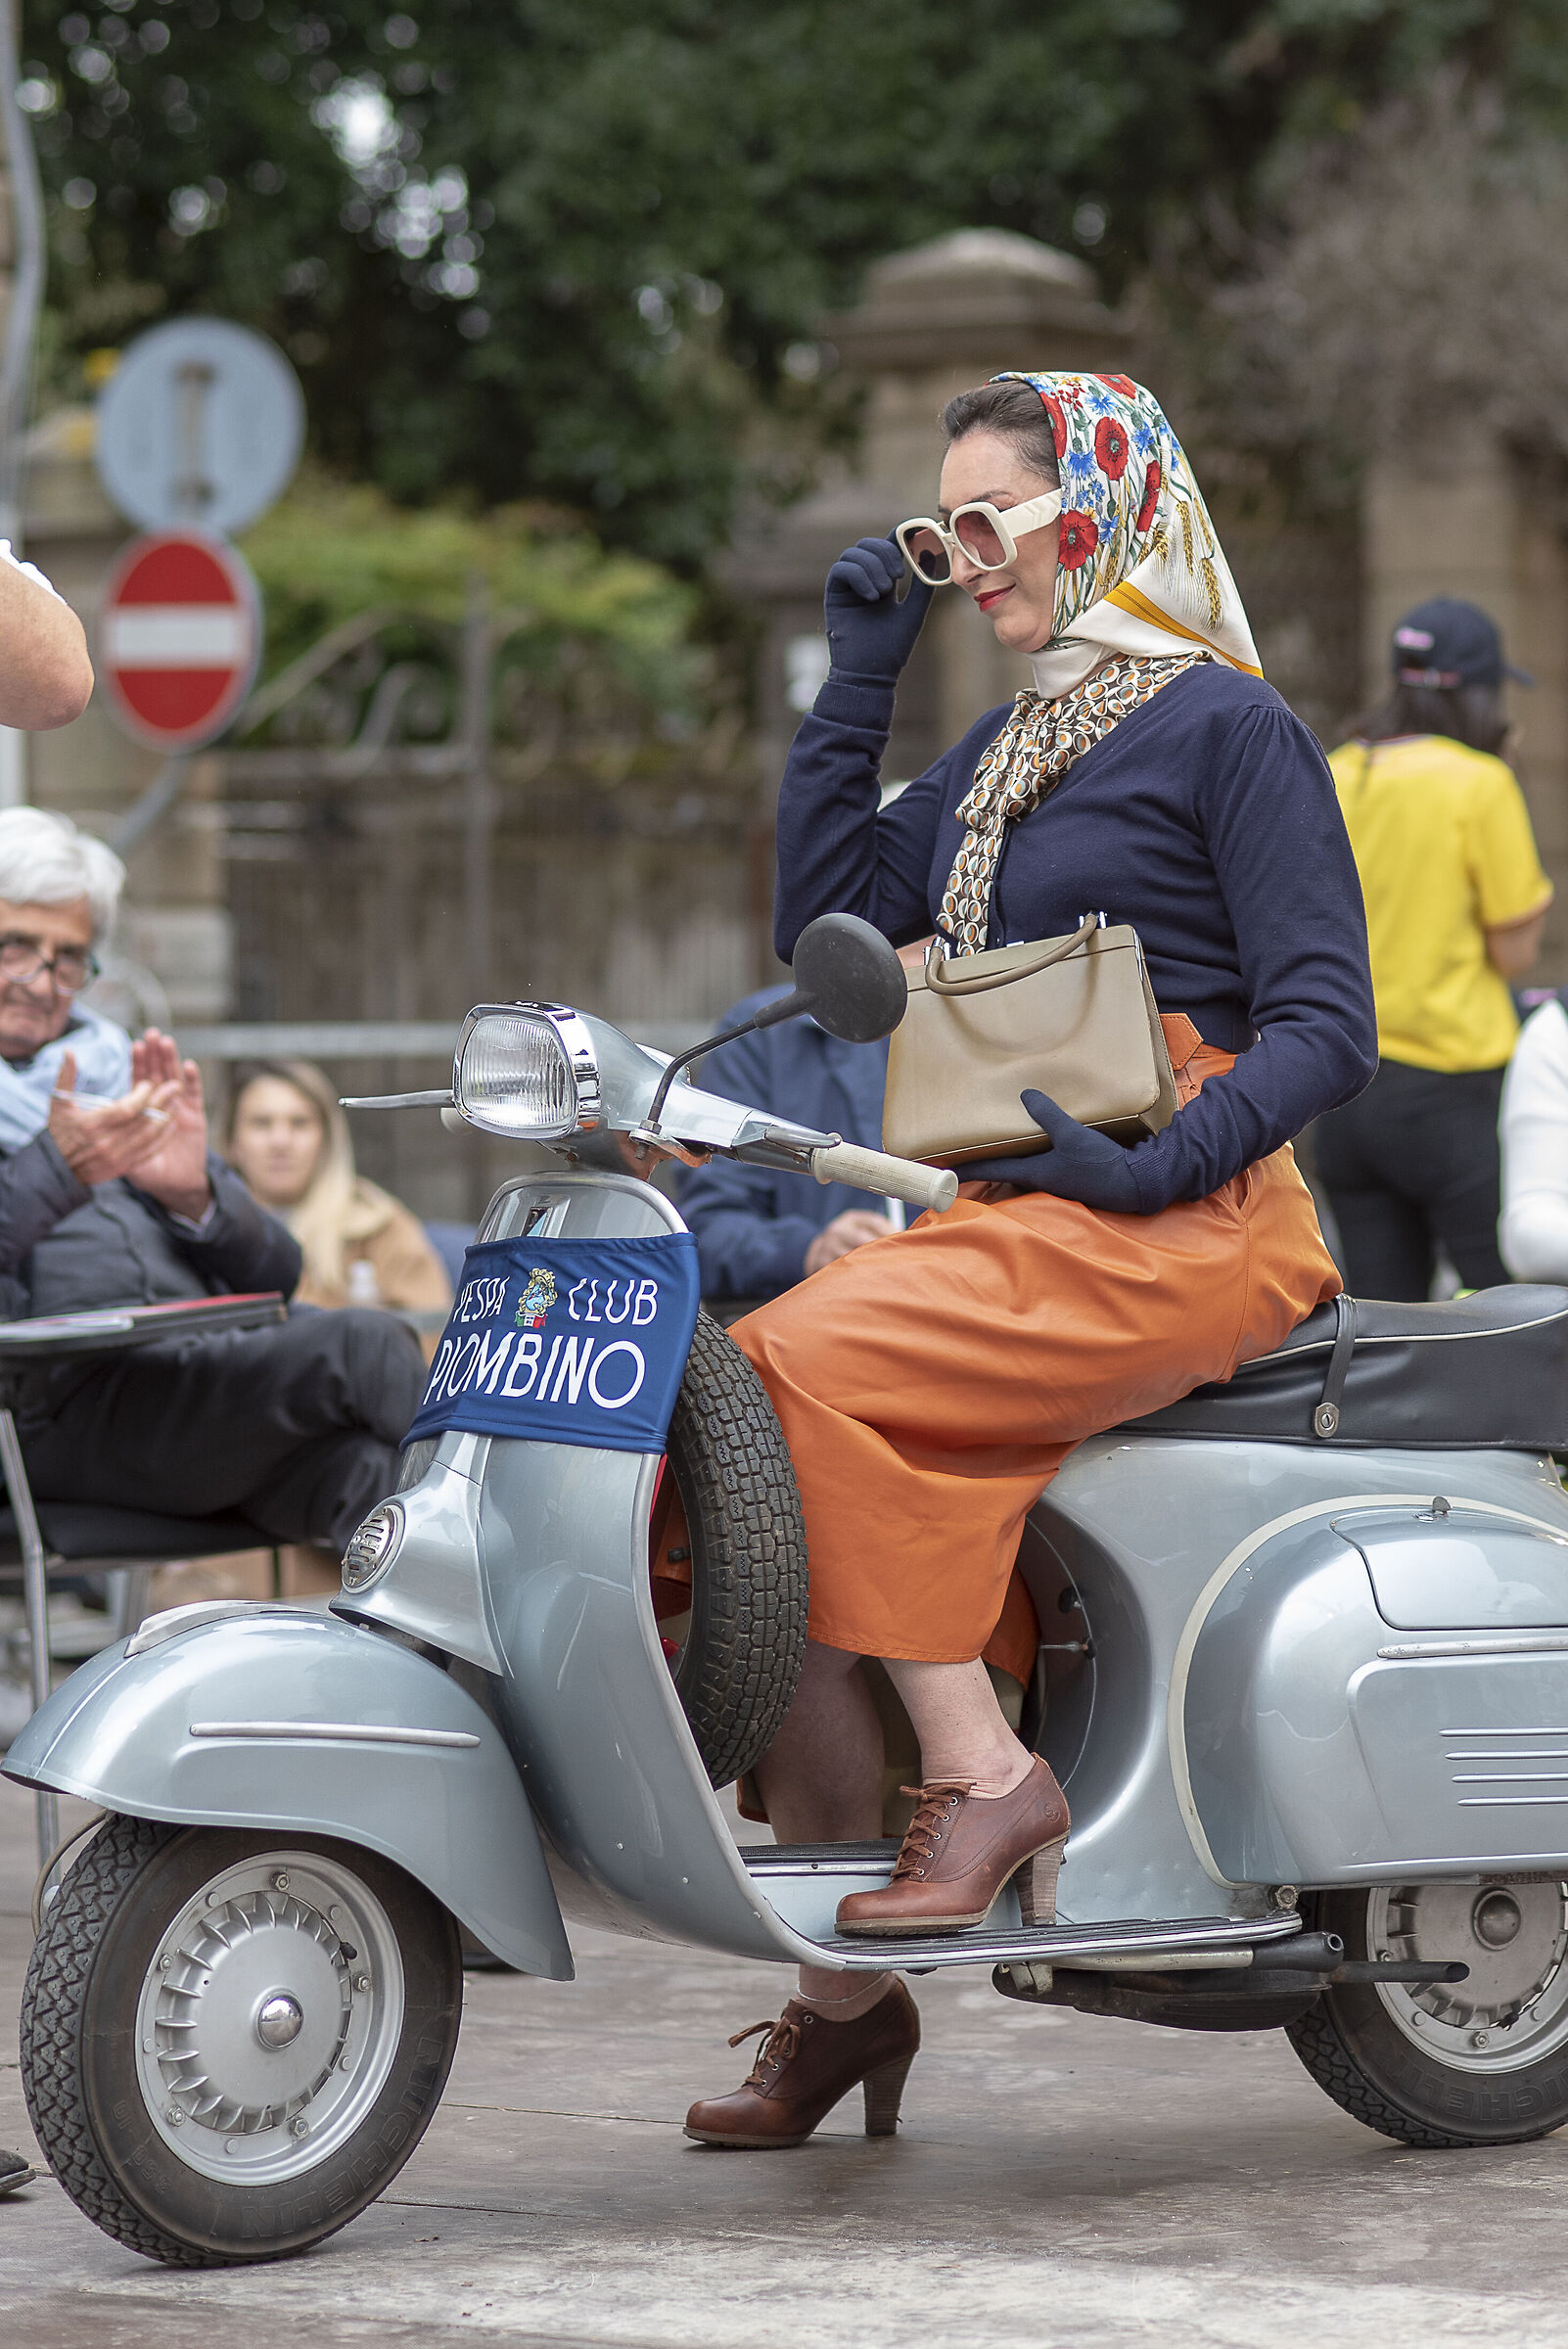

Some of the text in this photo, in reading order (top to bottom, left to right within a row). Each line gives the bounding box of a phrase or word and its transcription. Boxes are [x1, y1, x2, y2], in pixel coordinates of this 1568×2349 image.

[453, 1276, 658, 1325] VESPA CLUB
[423, 1329, 645, 1409] PIOMBINO
[242, 2037, 443, 2238] MICHELIN
